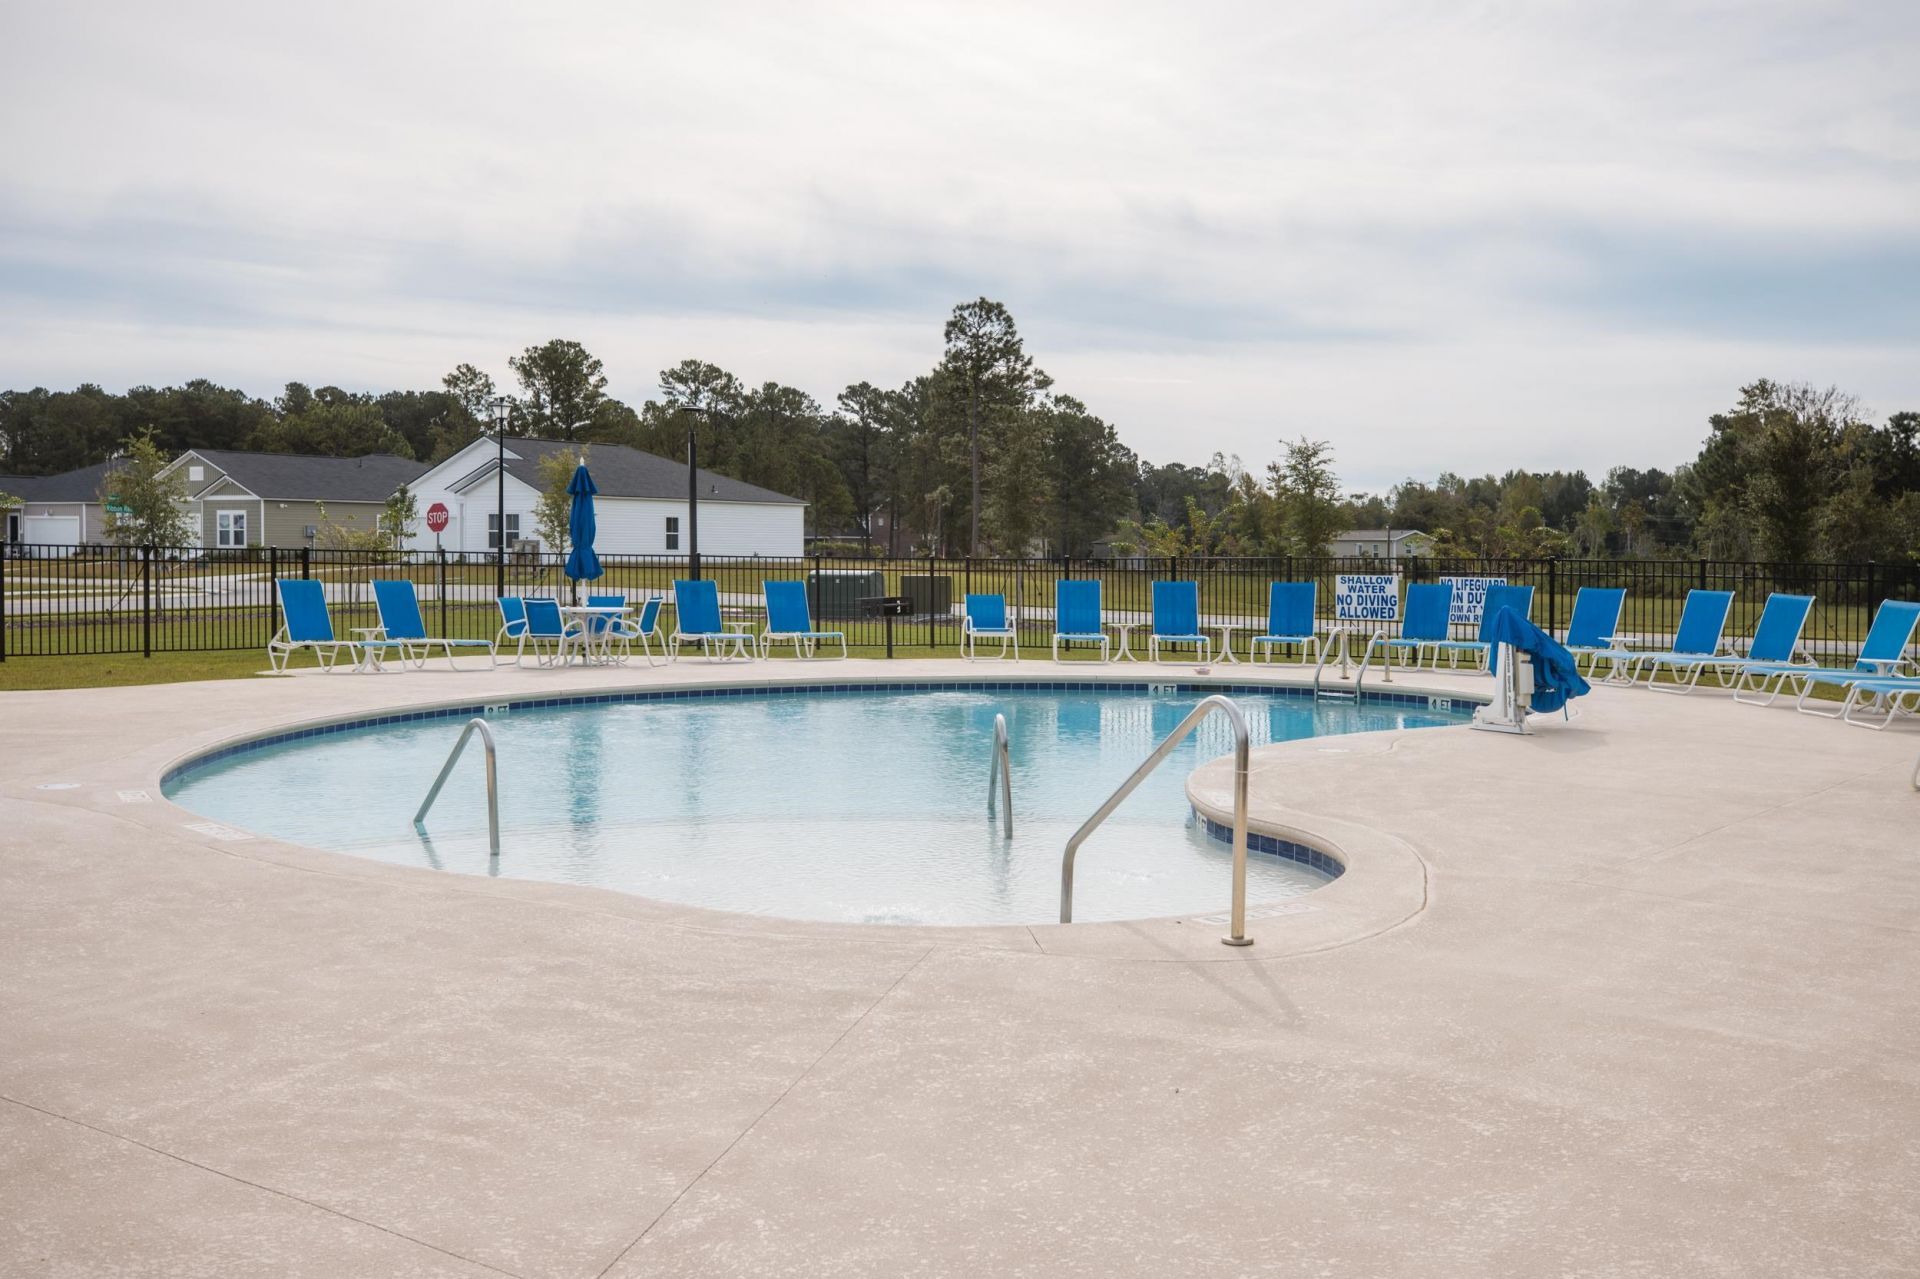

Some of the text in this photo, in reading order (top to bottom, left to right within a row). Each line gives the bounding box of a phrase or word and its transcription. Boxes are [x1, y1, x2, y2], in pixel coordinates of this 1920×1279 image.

[428, 511, 448, 524] STOP
[1340, 576, 1393, 585] SHALLOW
[1347, 585, 1386, 594] WATER
[1336, 594, 1398, 607] NO DIVING
[1339, 606, 1395, 619] ALLOWED
[1466, 605, 1477, 613] AT
[1450, 613, 1470, 622] OWN
